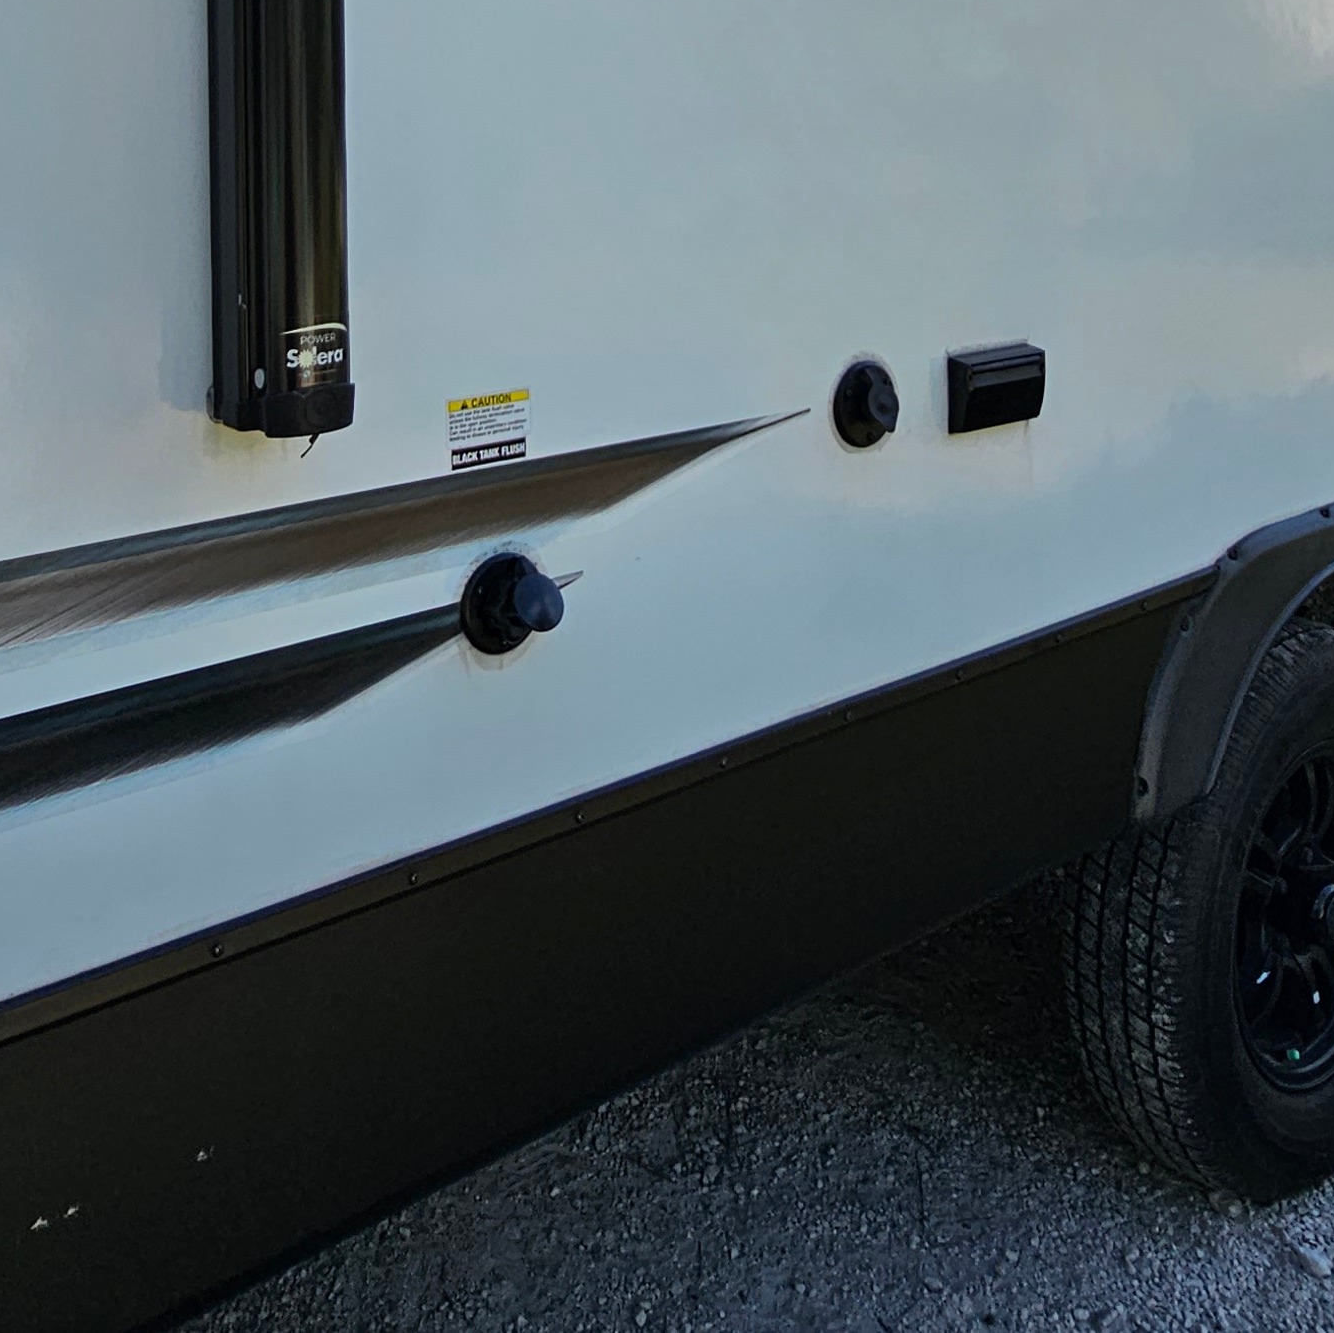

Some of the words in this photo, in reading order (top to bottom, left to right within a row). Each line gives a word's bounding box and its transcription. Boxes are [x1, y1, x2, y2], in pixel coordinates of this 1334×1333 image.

[300, 332, 337, 345] POWER
[286, 346, 344, 368] Solera
[471, 393, 512, 408] CAUTION
[452, 451, 478, 465] BLACK
[479, 447, 500, 460] TANK
[501, 442, 525, 456] FLUSH
